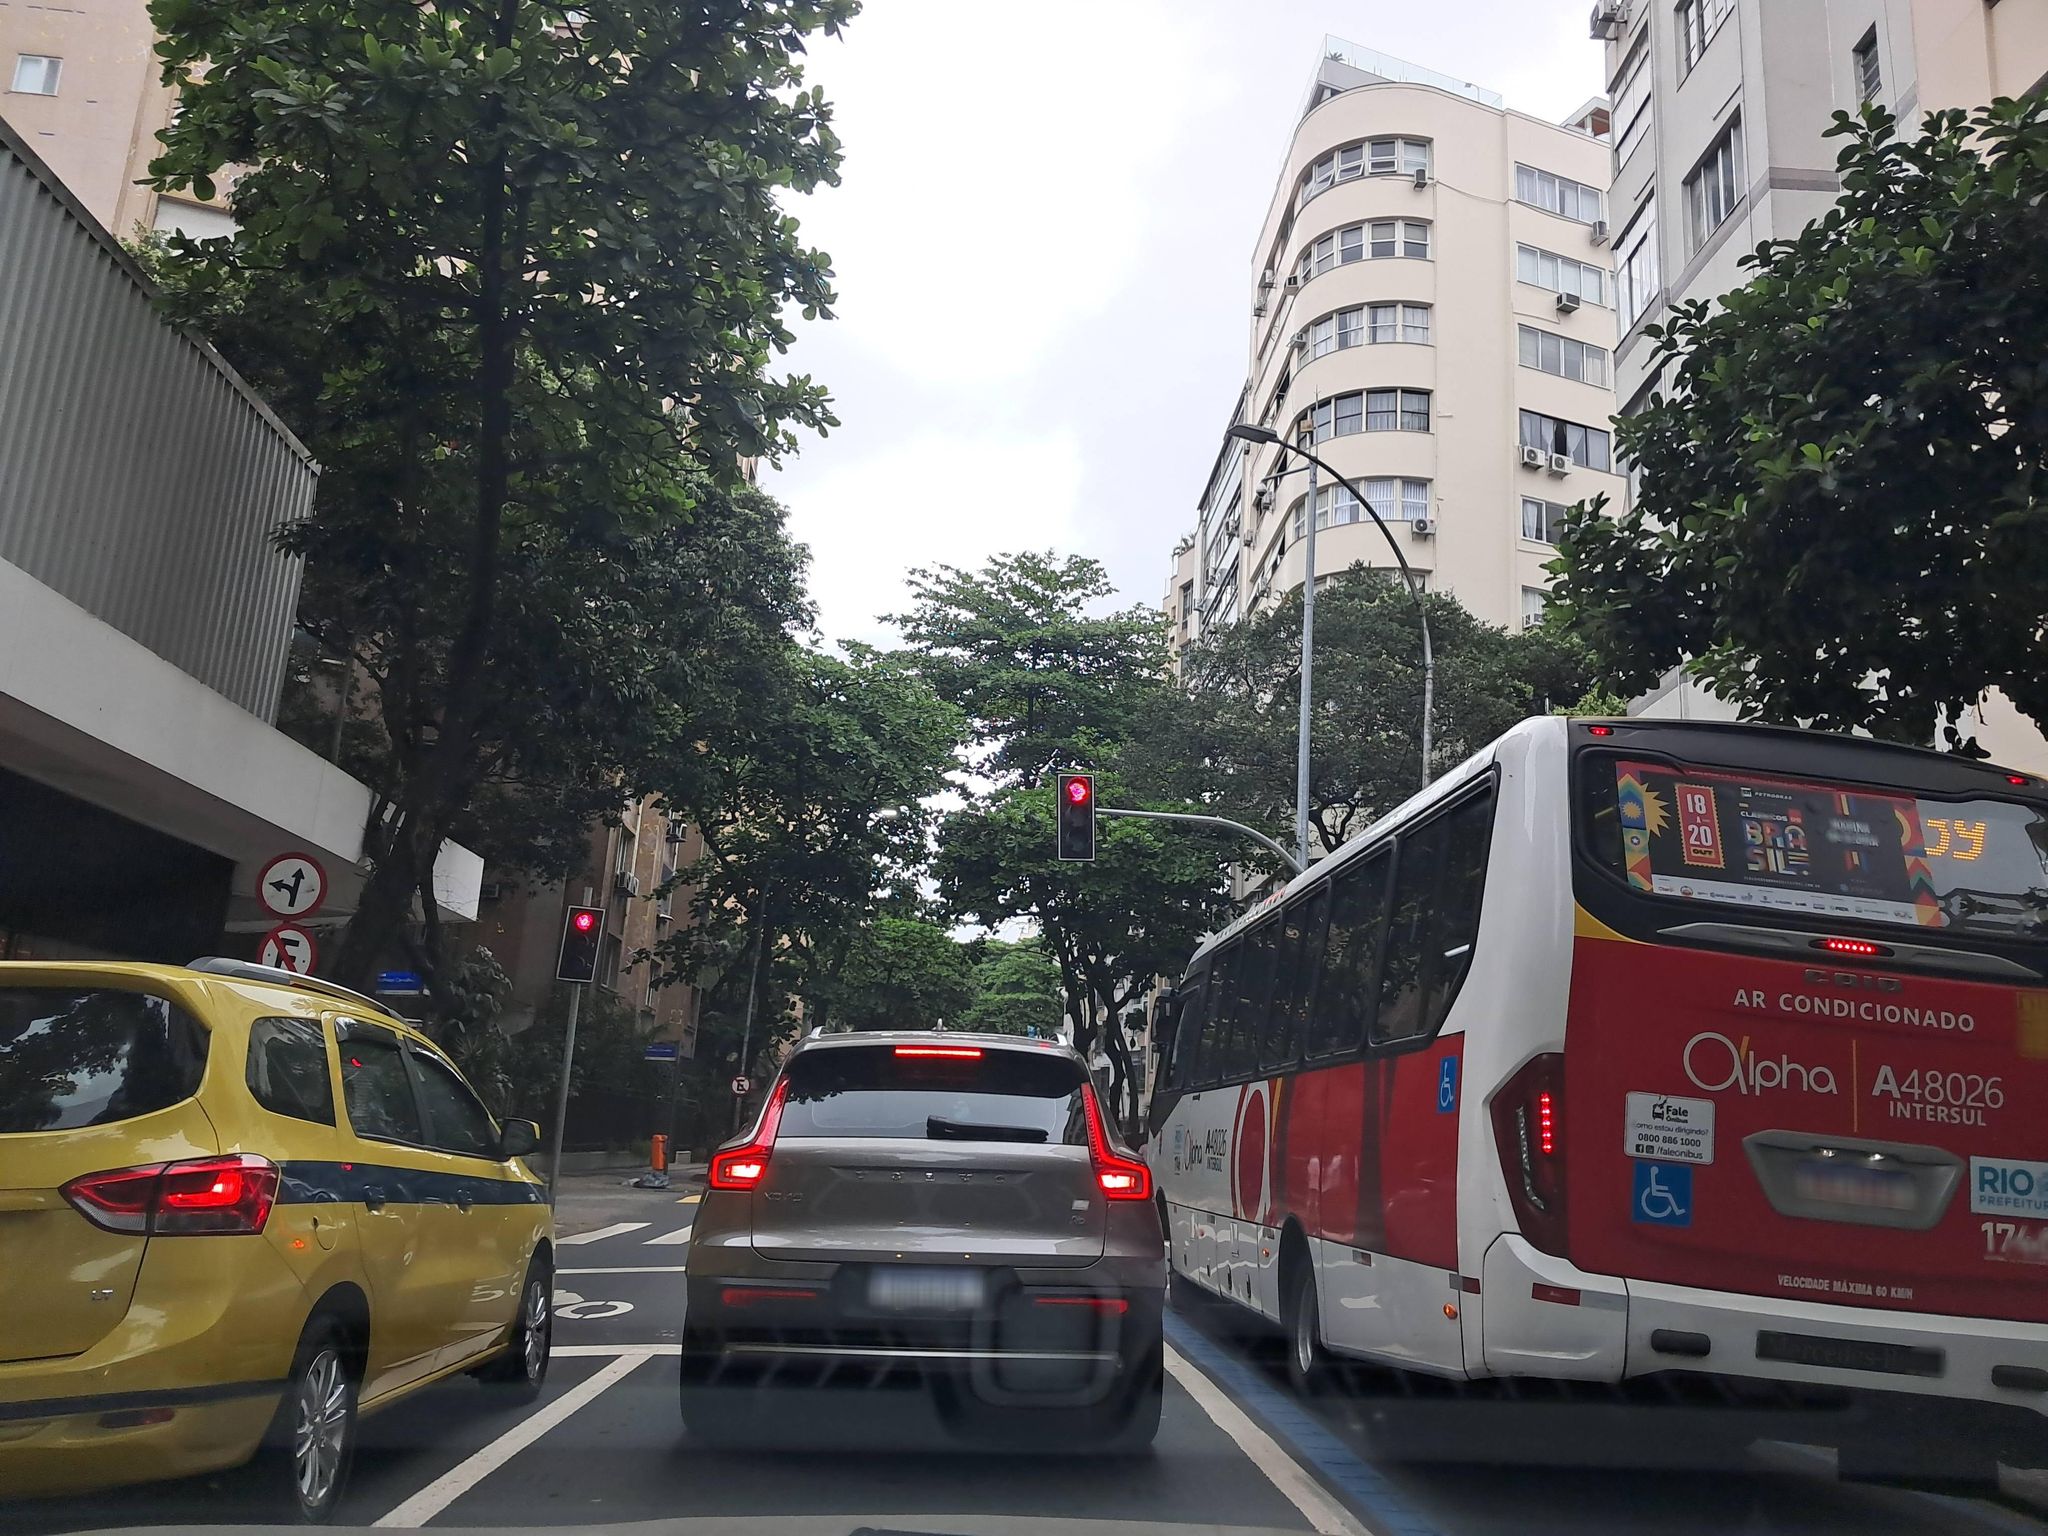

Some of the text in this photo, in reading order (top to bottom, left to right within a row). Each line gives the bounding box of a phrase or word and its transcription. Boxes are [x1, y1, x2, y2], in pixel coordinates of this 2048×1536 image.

[1686, 793, 1707, 815] 18
[1688, 824, 1713, 846] 20
[1692, 848, 1713, 856] OUT
[1733, 988, 1975, 1032] AR CONDICIONADO
[1871, 1064, 2005, 1109] A48026
[1665, 1105, 1689, 1117] Fale
[1888, 1100, 1987, 1127] INTERSUL
[1637, 1132, 1701, 1148] 0800 886 1000
[1654, 1124, 1674, 1132] estou
[1674, 1126, 1709, 1136] dirigindo?
[1978, 1165, 2035, 1197] RIO
[1777, 1274, 1830, 1291] VELOCIDADE
[1832, 1279, 1872, 1296] MÁXIMA
[1875, 1286, 1888, 1297] 60
